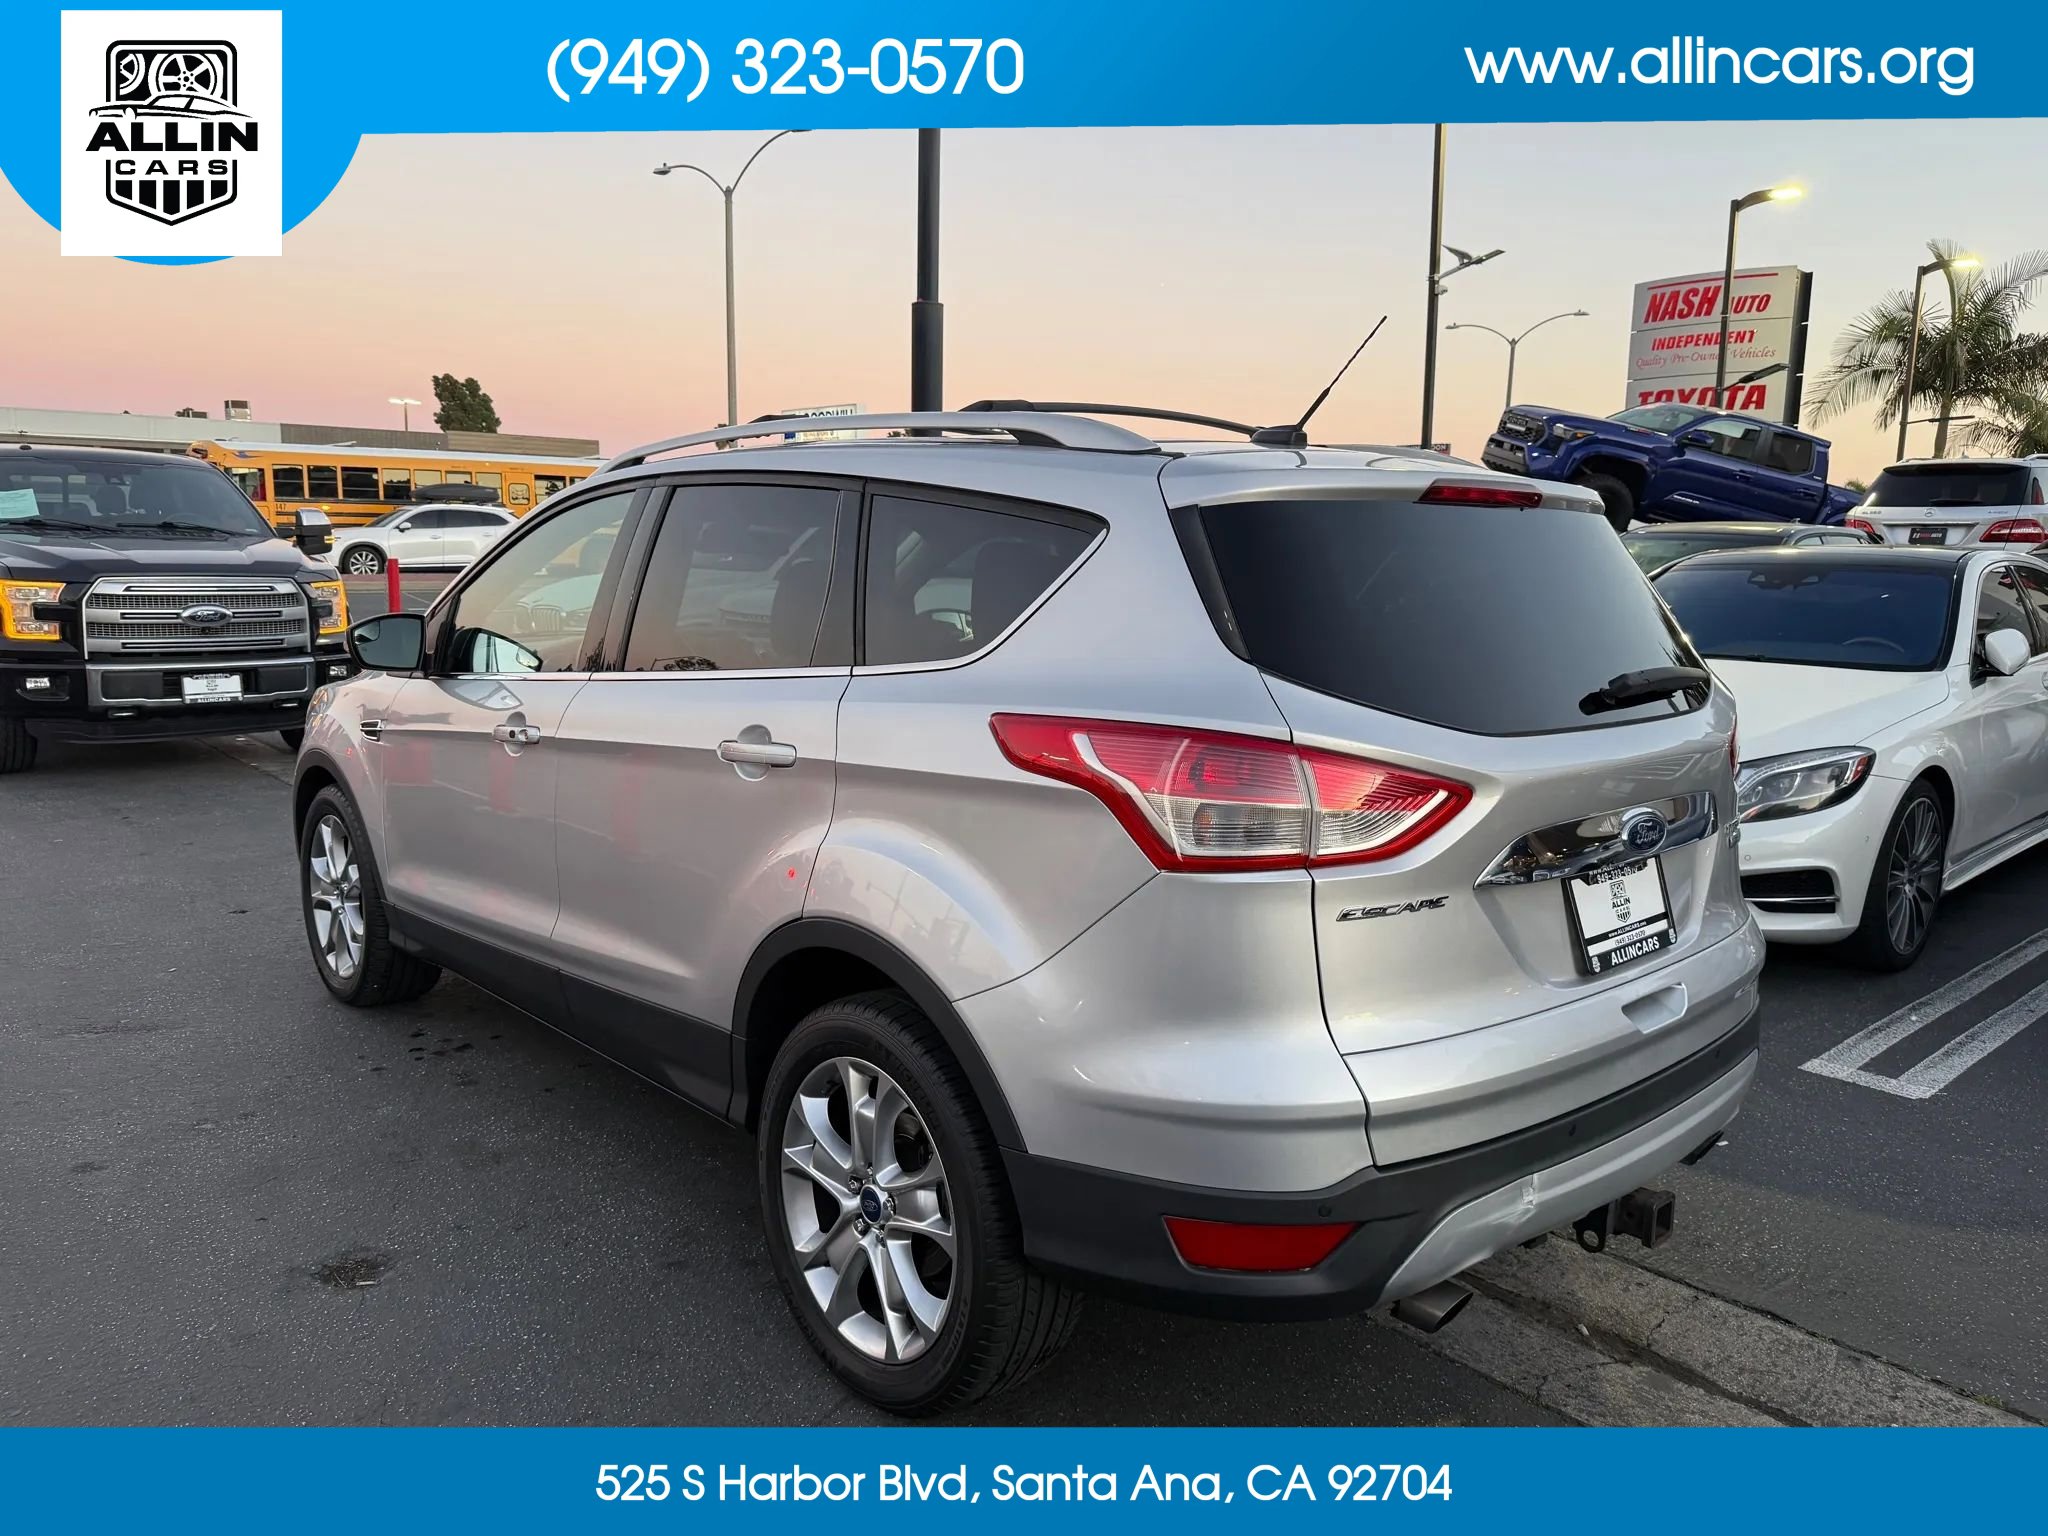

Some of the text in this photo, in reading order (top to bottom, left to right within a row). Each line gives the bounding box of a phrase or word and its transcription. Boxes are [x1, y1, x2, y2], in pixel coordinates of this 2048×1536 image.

[1643, 285, 1771, 324] NASH UTO
[1635, 354, 1667, 370] Quality
[1732, 346, 1776, 359] Vehicles
[1637, 821, 1663, 844] Ford
[1336, 896, 1449, 921] ESCAPE
[1612, 897, 1631, 909] ALLIN
[1611, 936, 1660, 966] ALLINCARS
